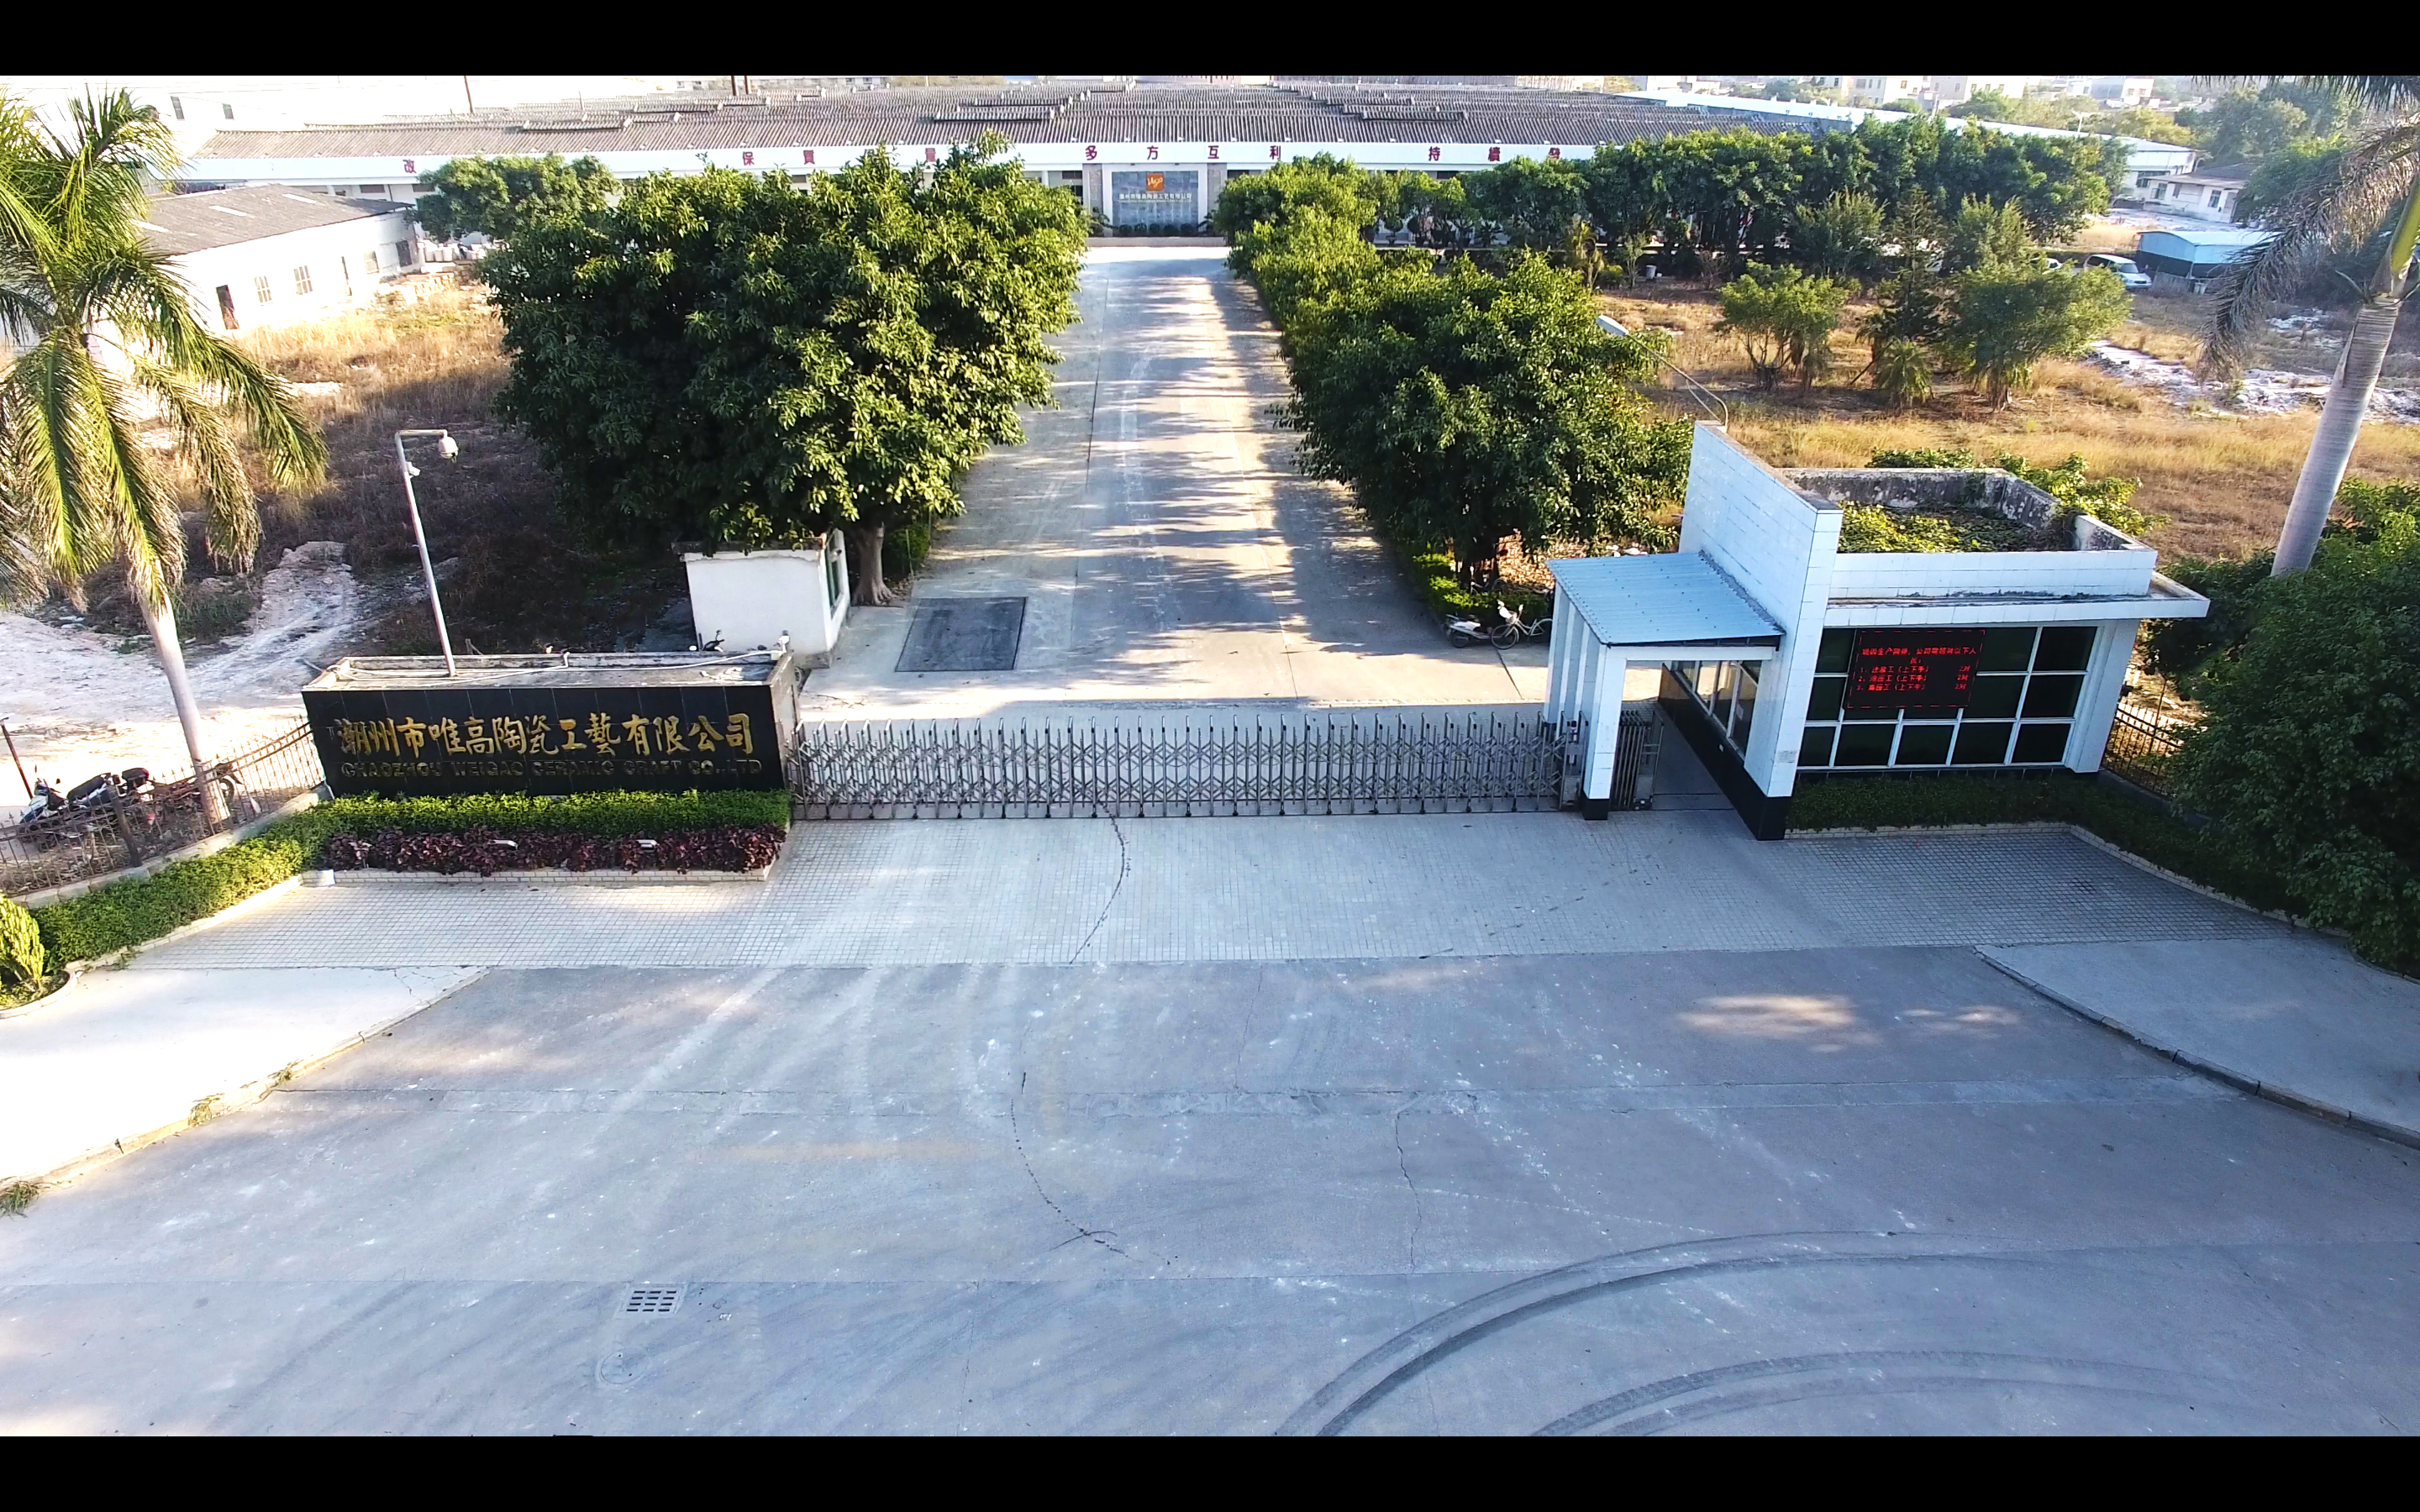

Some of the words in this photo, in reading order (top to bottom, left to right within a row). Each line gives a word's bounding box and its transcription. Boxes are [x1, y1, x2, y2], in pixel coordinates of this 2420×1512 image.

[1085, 145, 1281, 160] 多方互利
[334, 712, 754, 759] 潮州市唯高陶瓷工藝有限公司
[340, 762, 443, 777] CHAOZHOU
[451, 762, 523, 777] WEIGAO
[531, 760, 614, 777] CERAMIC
[623, 760, 681, 776] CRAFT
